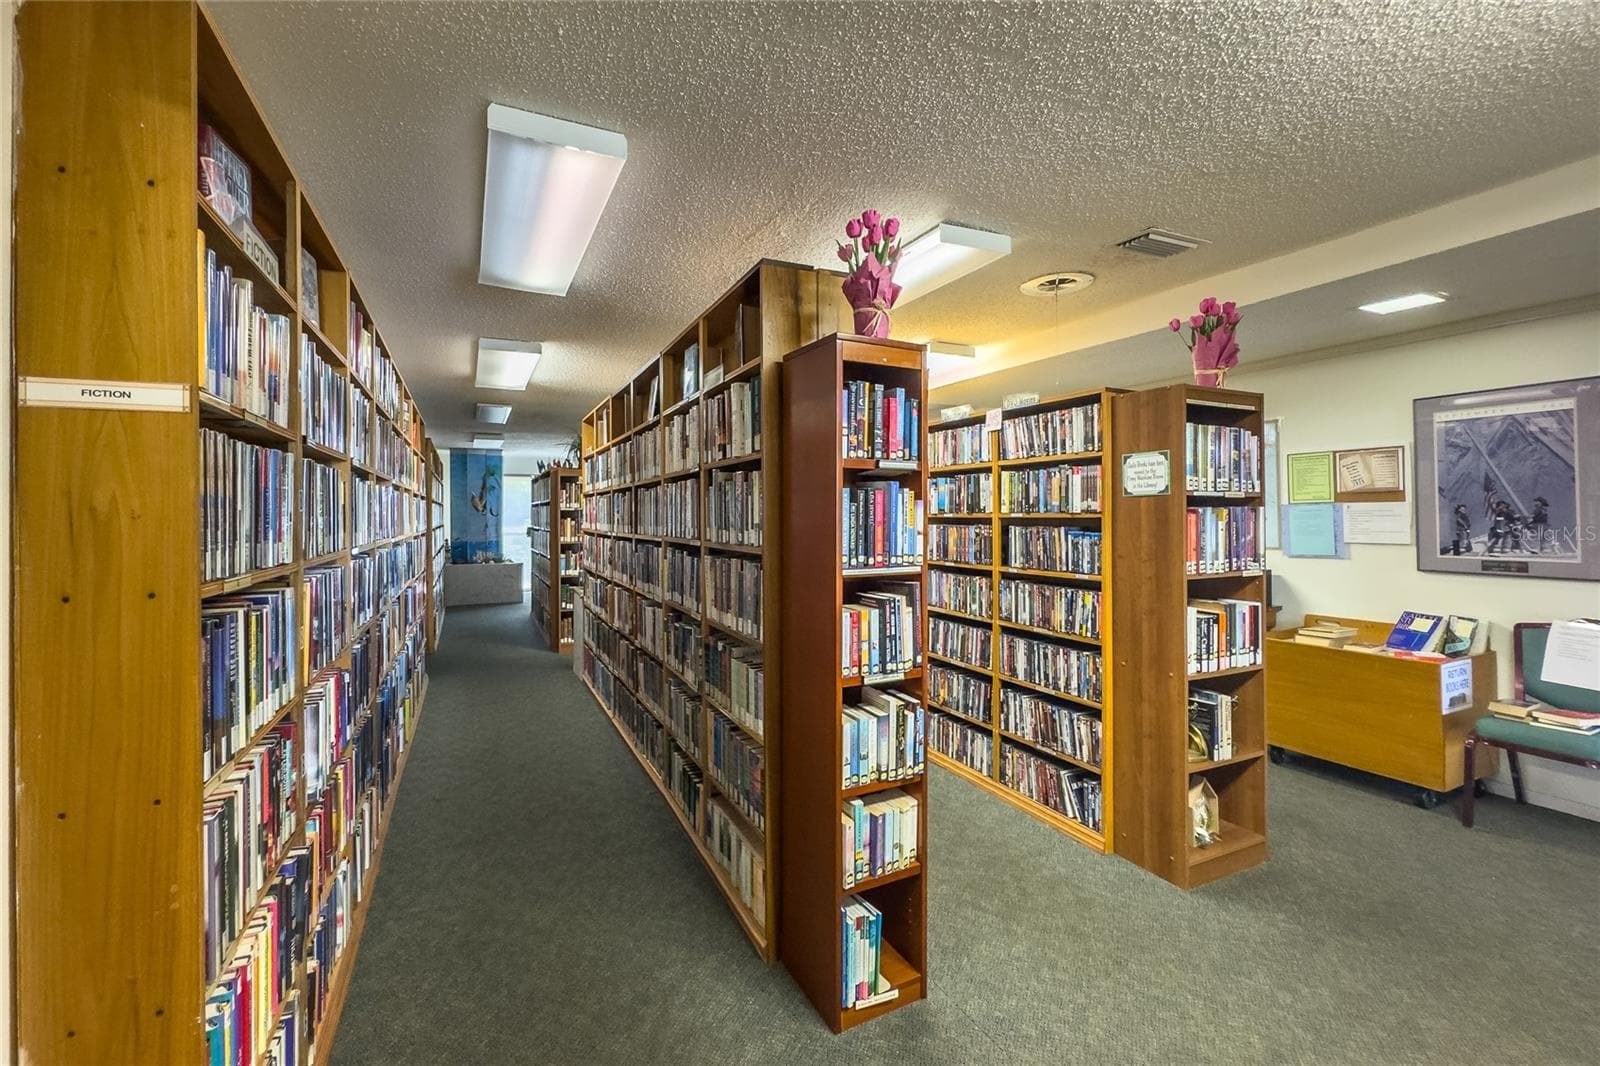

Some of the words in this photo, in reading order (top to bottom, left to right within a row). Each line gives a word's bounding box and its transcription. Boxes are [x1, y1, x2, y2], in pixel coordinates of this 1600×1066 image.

[246, 232, 277, 284] FICTION
[81, 388, 132, 399] FICTION
[1447, 667, 1467, 679] RETURN
[1445, 681, 1459, 693] BOOKS
